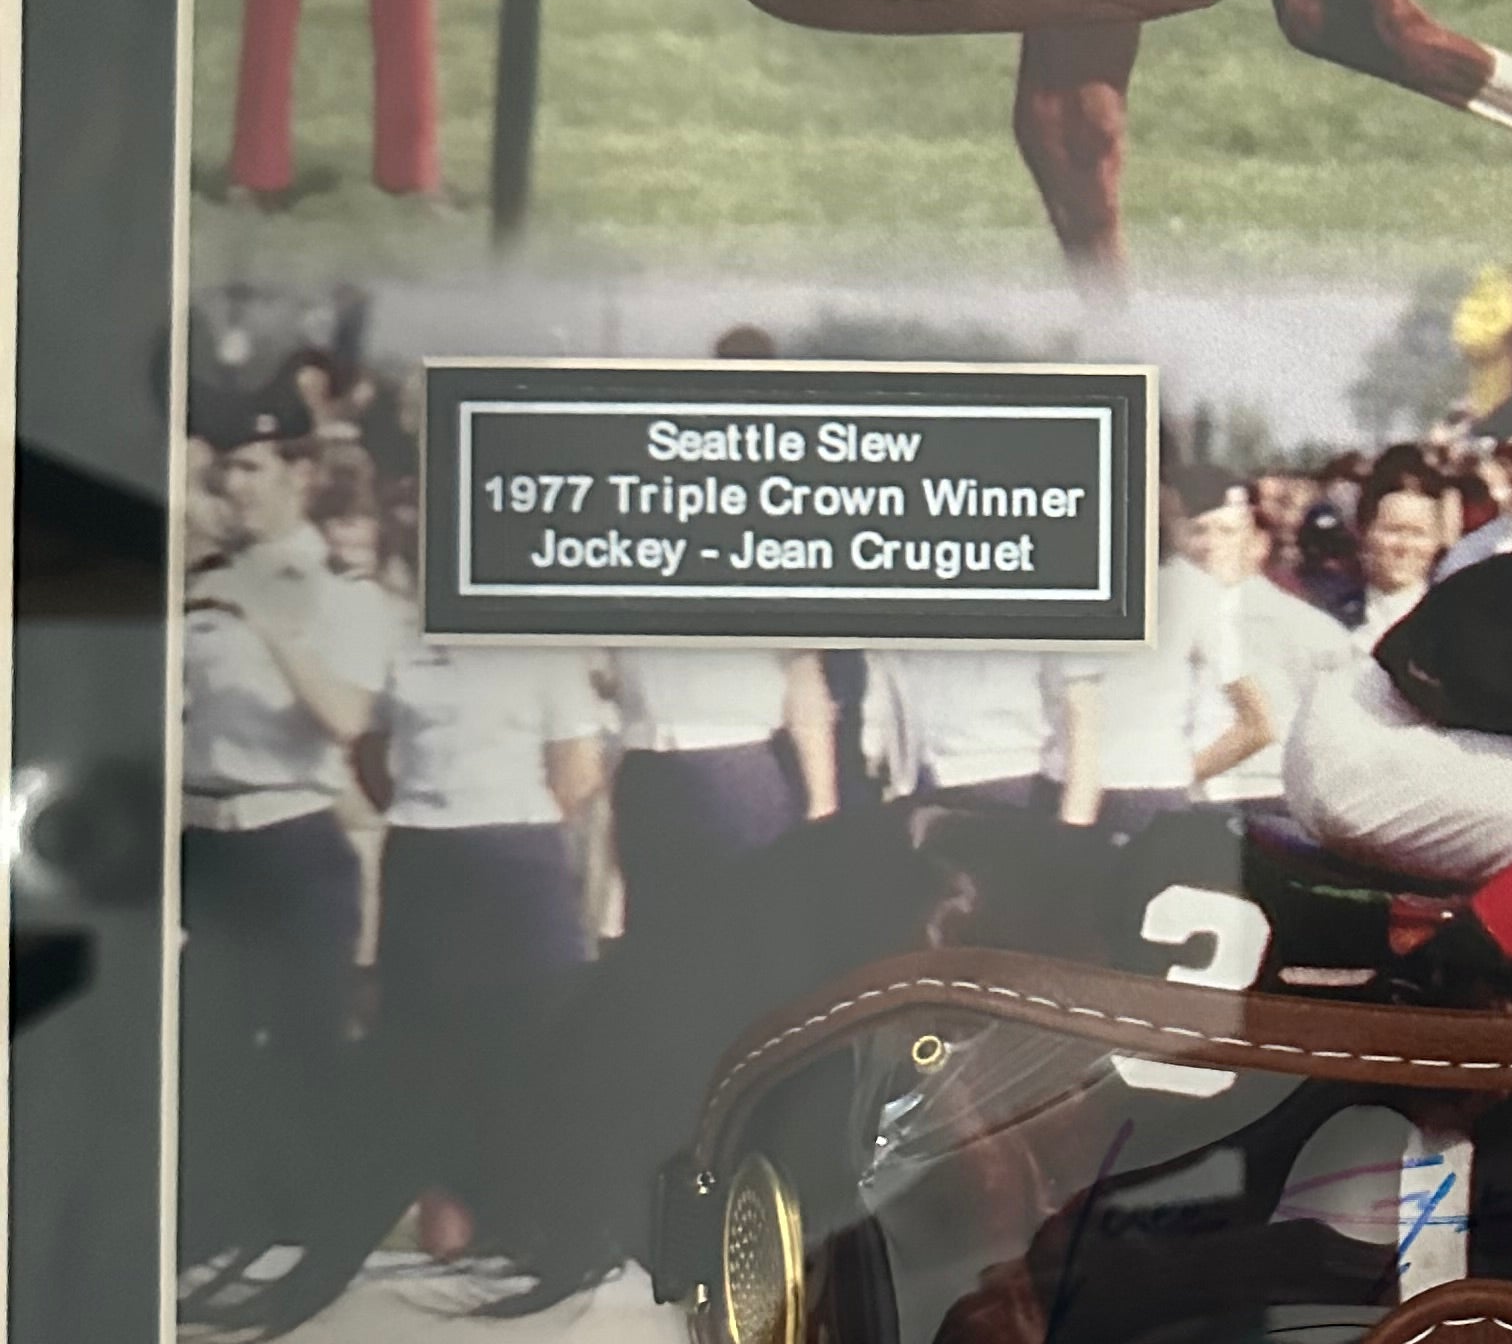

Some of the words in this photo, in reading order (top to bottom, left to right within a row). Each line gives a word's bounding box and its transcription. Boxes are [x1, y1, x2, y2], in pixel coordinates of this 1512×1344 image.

[648, 421, 805, 461] Seattle
[817, 422, 921, 462] Slew
[486, 476, 593, 512] 1977
[608, 476, 746, 522] Triple
[760, 477, 904, 515] Crown
[922, 479, 1084, 517] Winner
[531, 530, 686, 576] Jockey
[701, 549, 719, 558] -
[730, 531, 832, 569] Jean
[851, 531, 1034, 579] Cruguet
